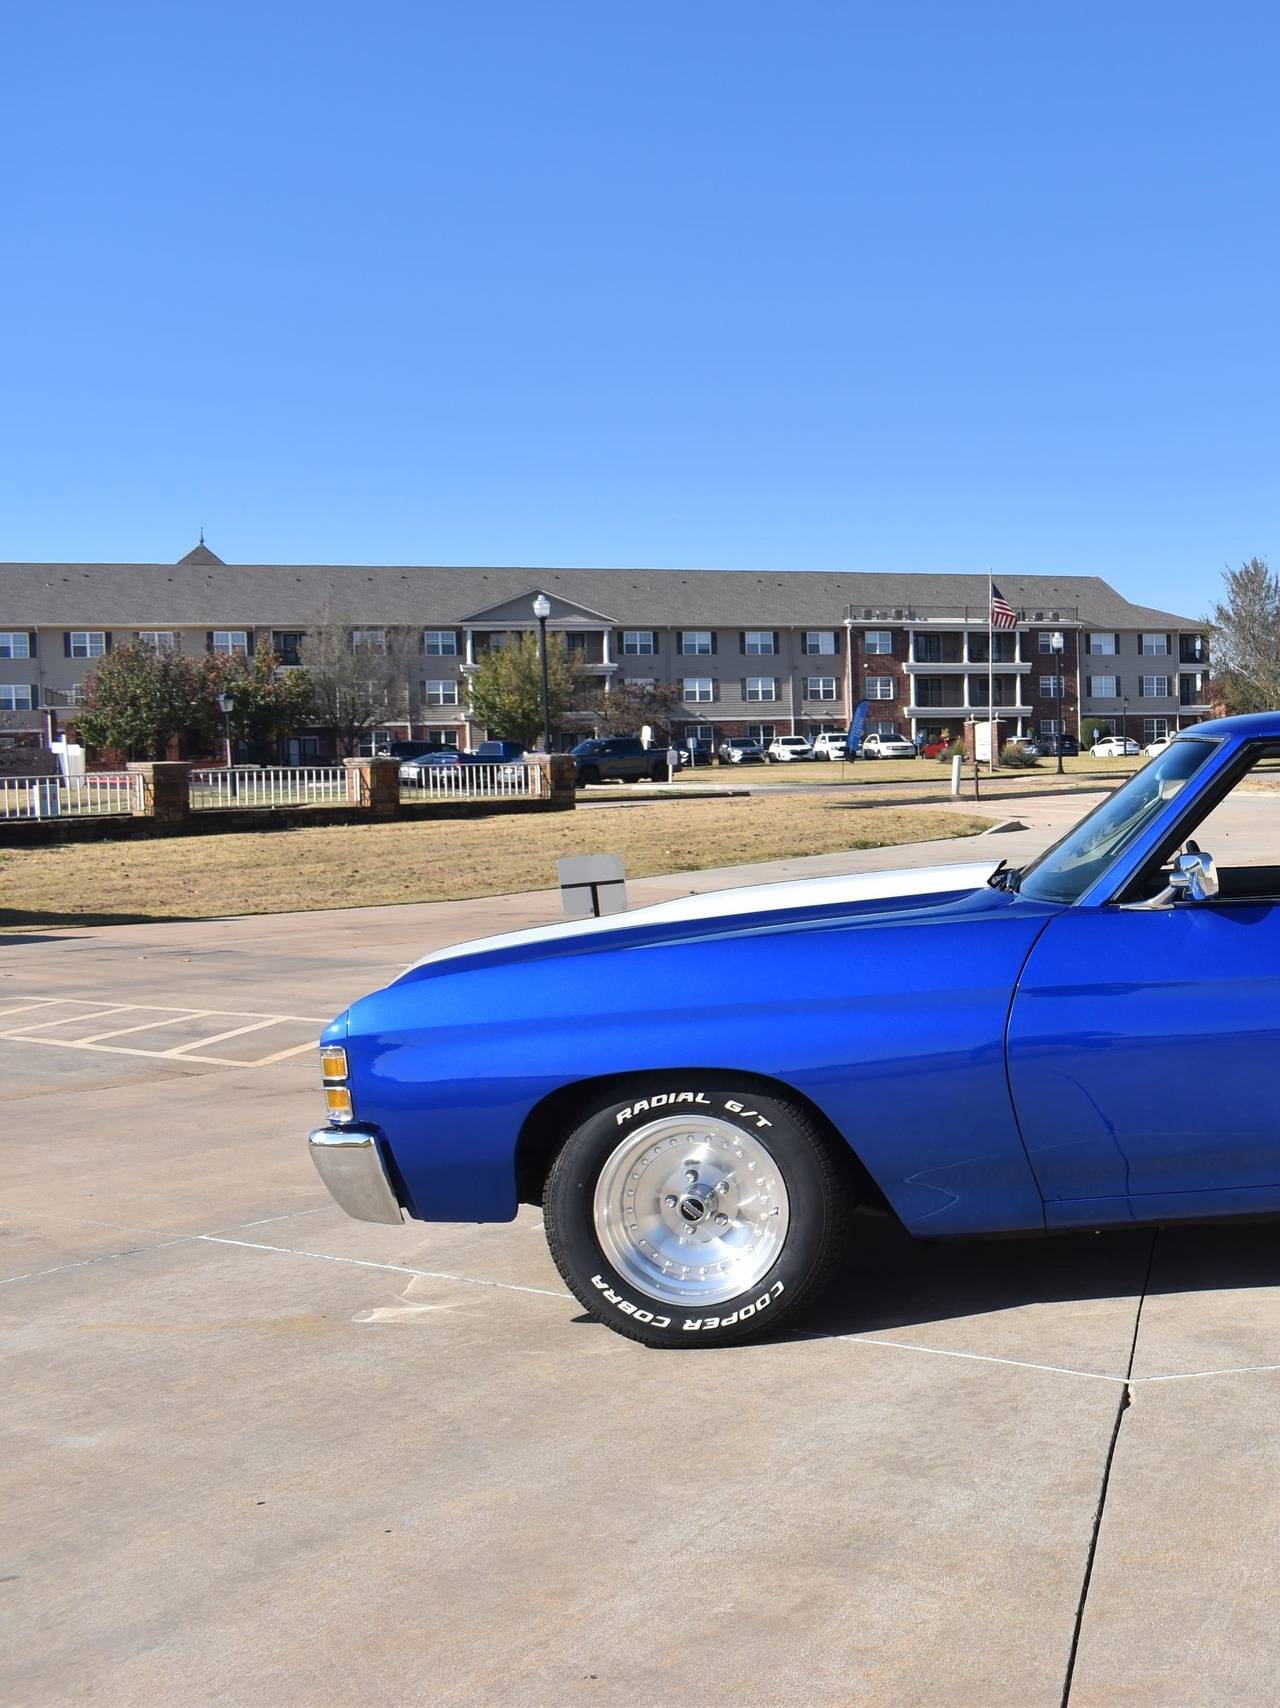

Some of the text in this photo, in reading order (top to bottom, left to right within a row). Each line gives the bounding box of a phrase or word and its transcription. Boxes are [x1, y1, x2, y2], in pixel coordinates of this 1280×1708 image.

[615, 1091, 773, 1129] RADIAL G/T
[590, 1274, 785, 1331] COOPER COBRA
